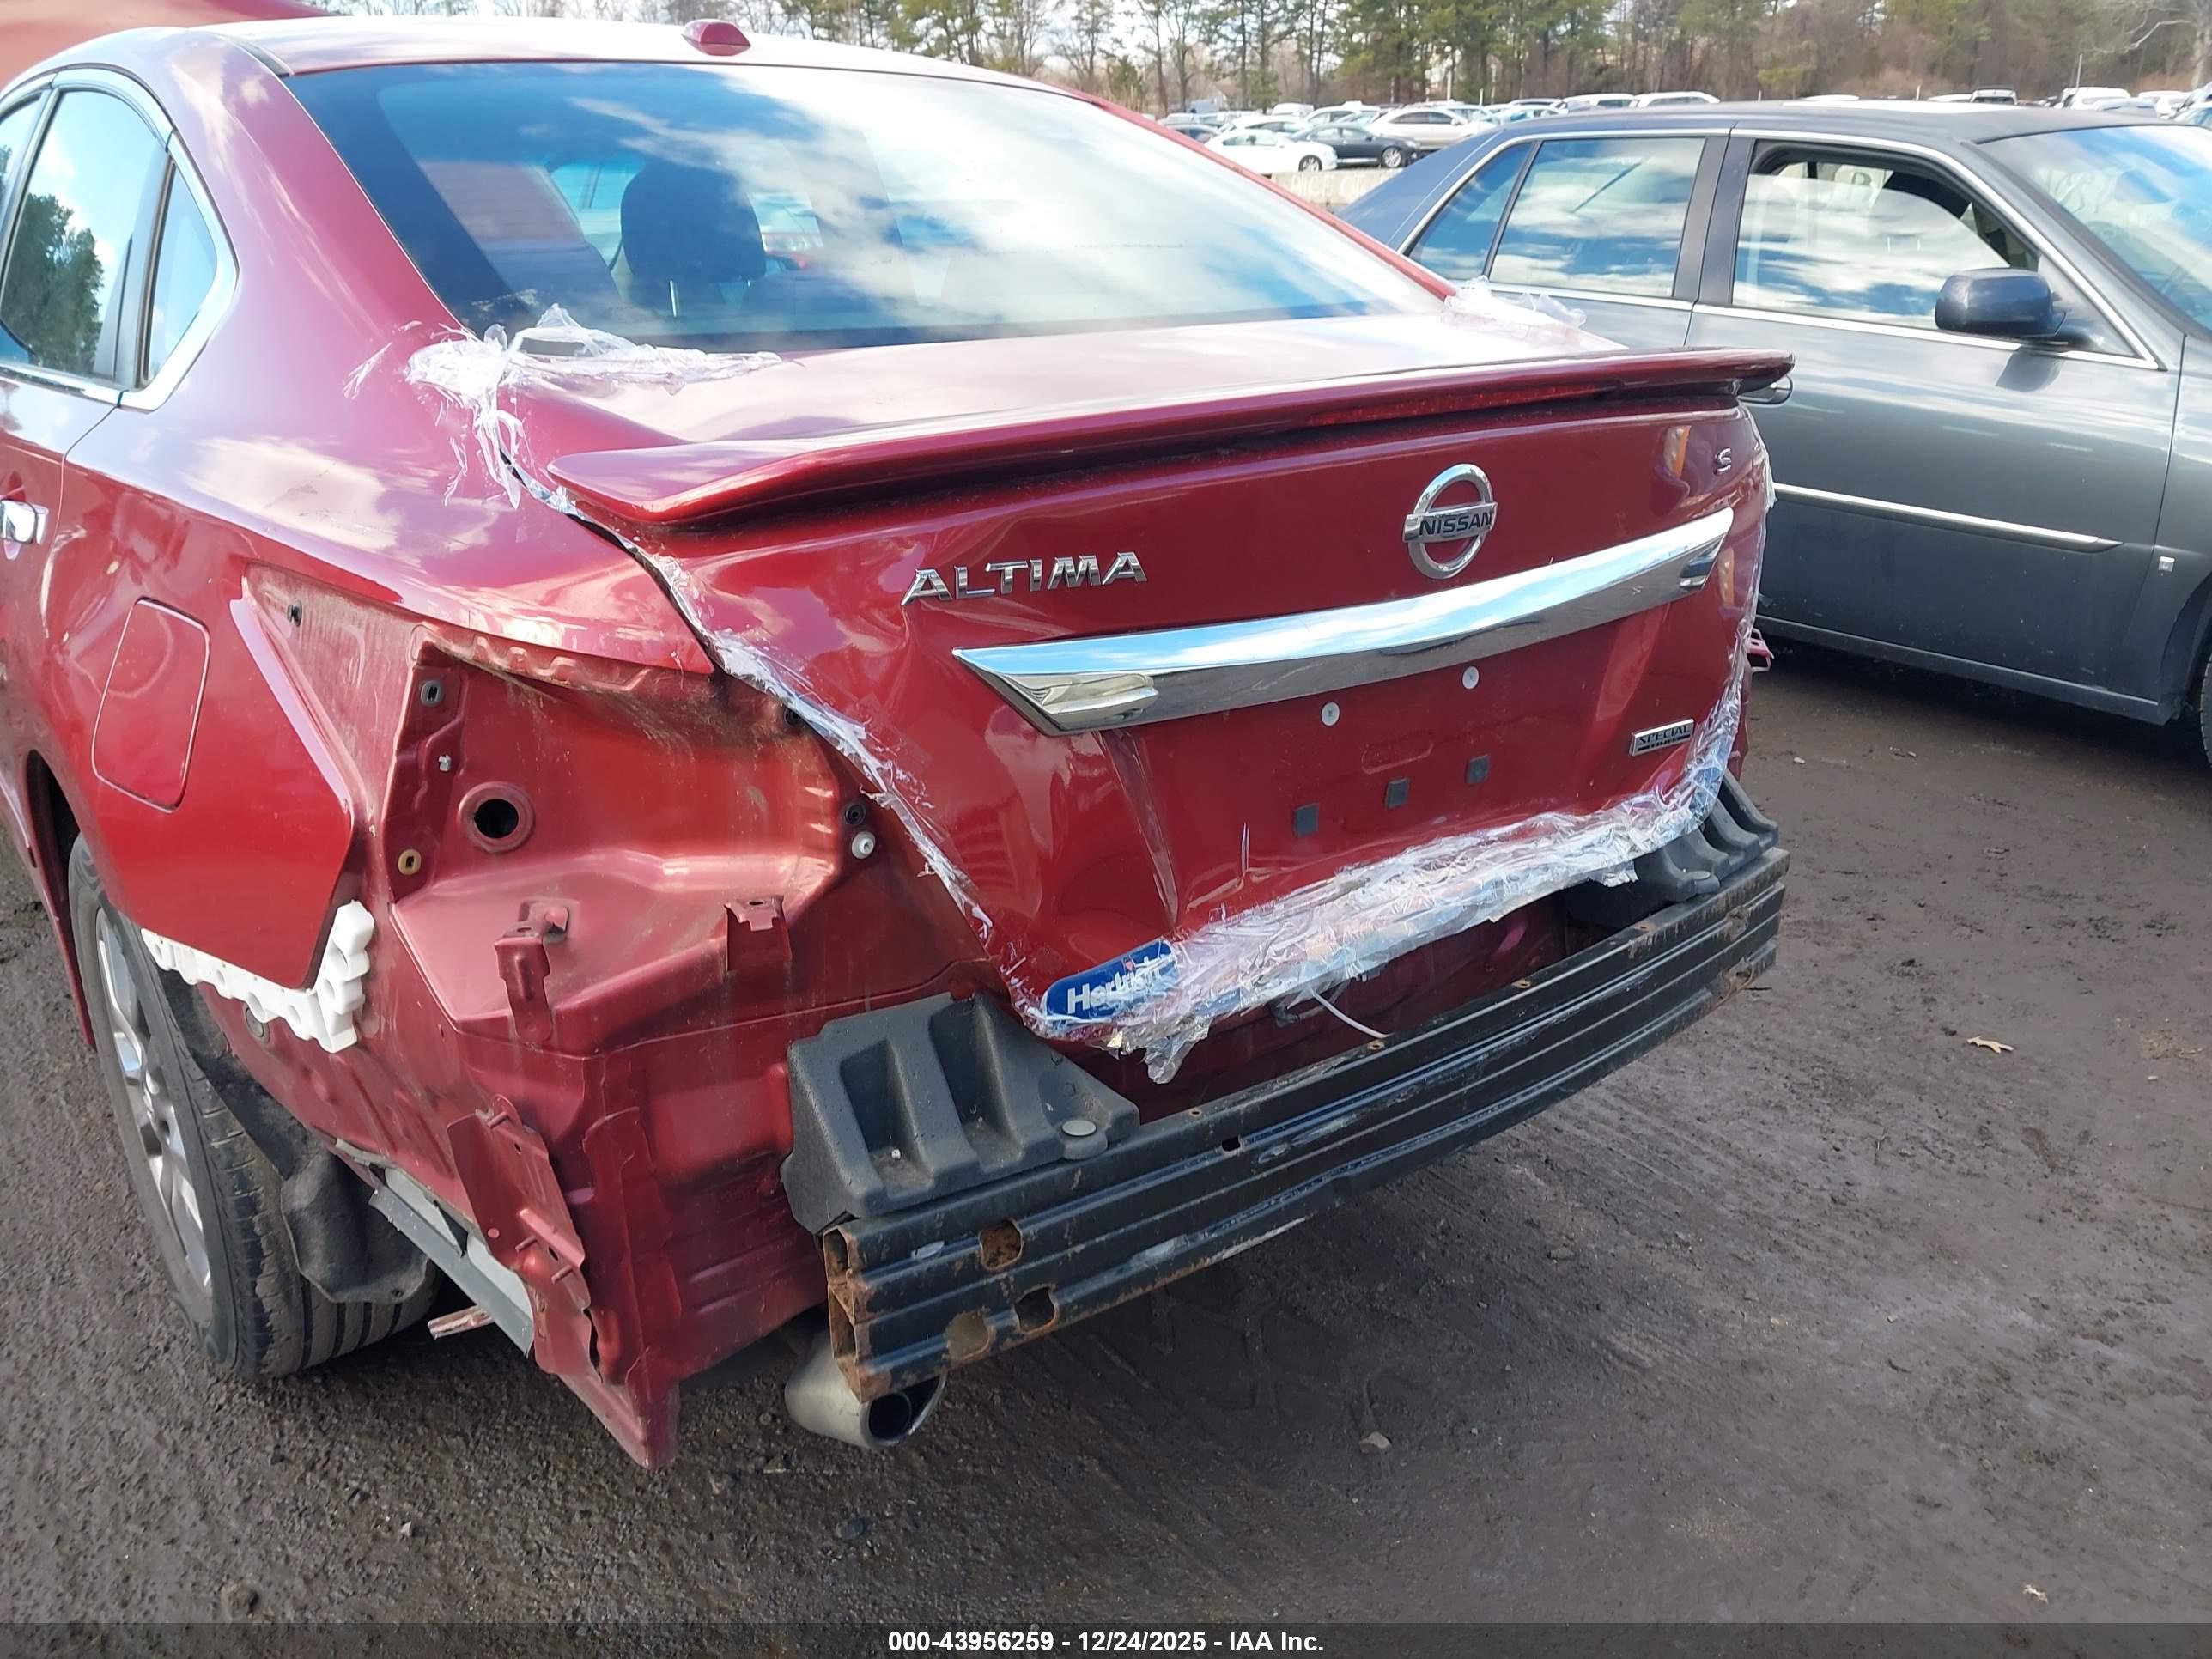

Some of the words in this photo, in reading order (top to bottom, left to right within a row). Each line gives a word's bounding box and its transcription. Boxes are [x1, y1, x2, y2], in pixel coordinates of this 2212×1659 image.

[1716, 447, 1732, 472] S
[1419, 511, 1492, 536] NISSAN
[902, 551, 1148, 605] ALTIMA
[1637, 723, 1691, 744] SPECIAL
